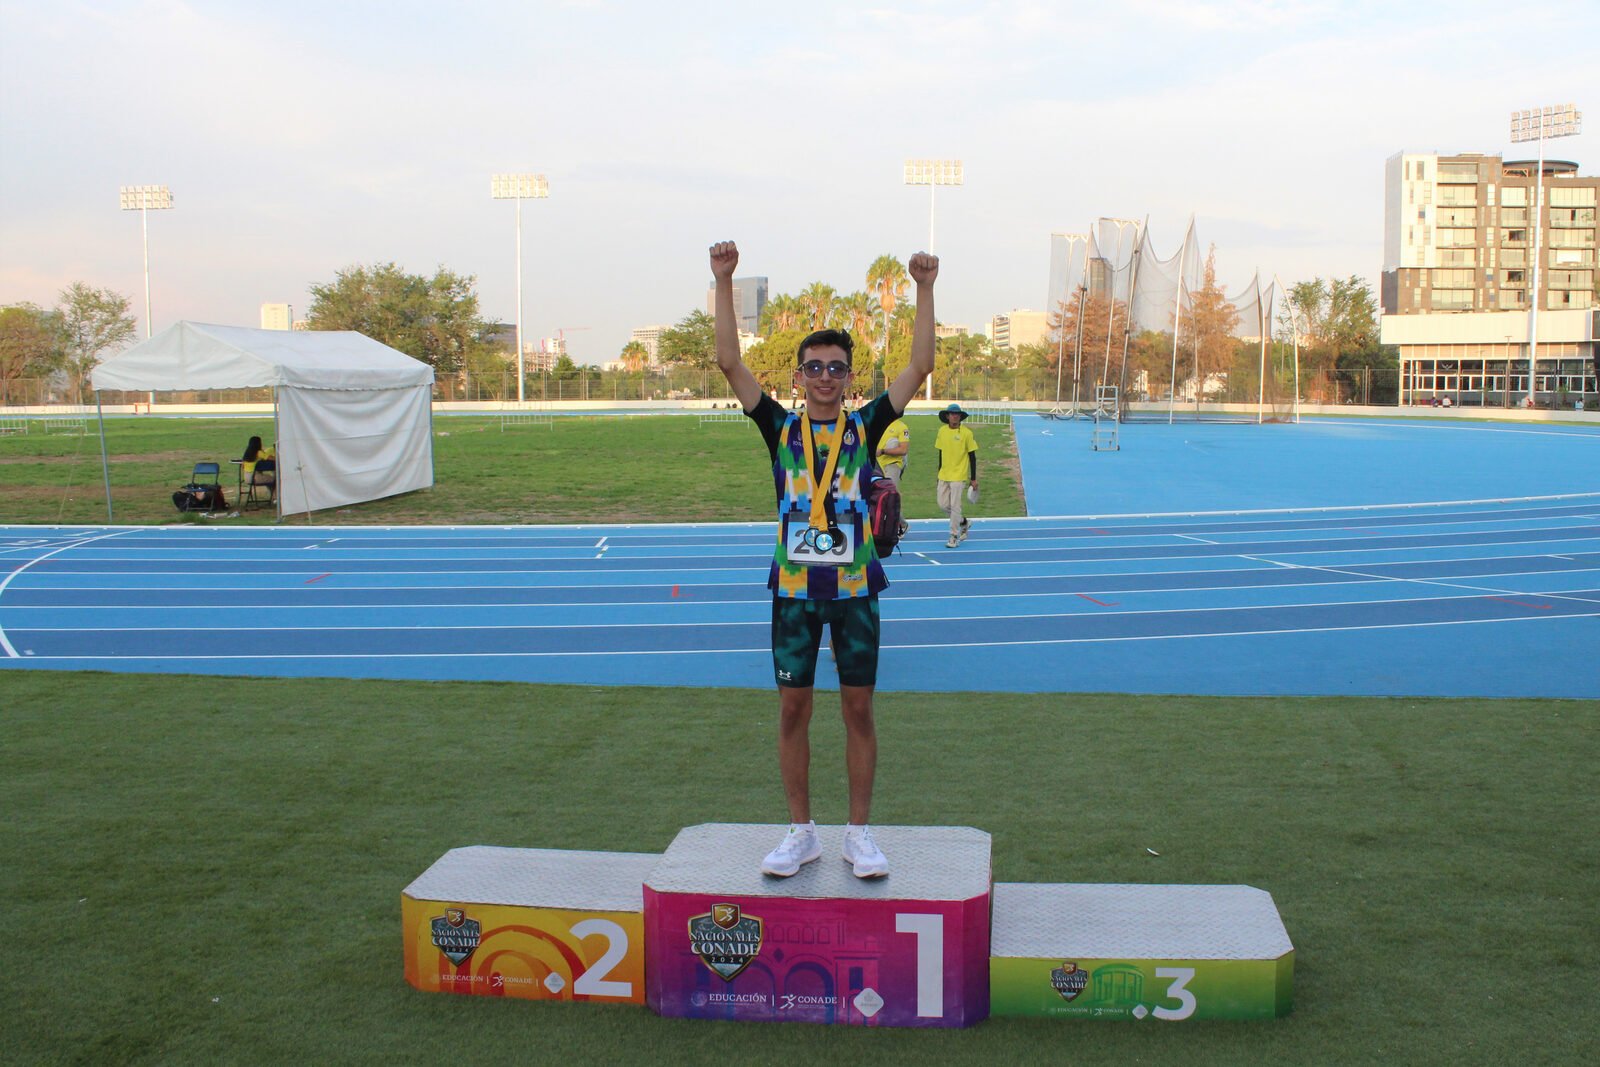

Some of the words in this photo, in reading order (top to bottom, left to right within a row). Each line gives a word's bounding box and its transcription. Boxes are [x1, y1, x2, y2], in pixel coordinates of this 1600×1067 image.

[793, 529, 848, 556] 29
[690, 931, 760, 942] NACIONALES
[569, 918, 632, 998] 2
[691, 942, 759, 956] CONADE
[711, 956, 744, 964] 2024
[895, 913, 944, 1018] 1
[709, 992, 767, 1003] EDUCACIÓN
[797, 995, 838, 1004] CONADE
[1152, 967, 1197, 1021] 3
